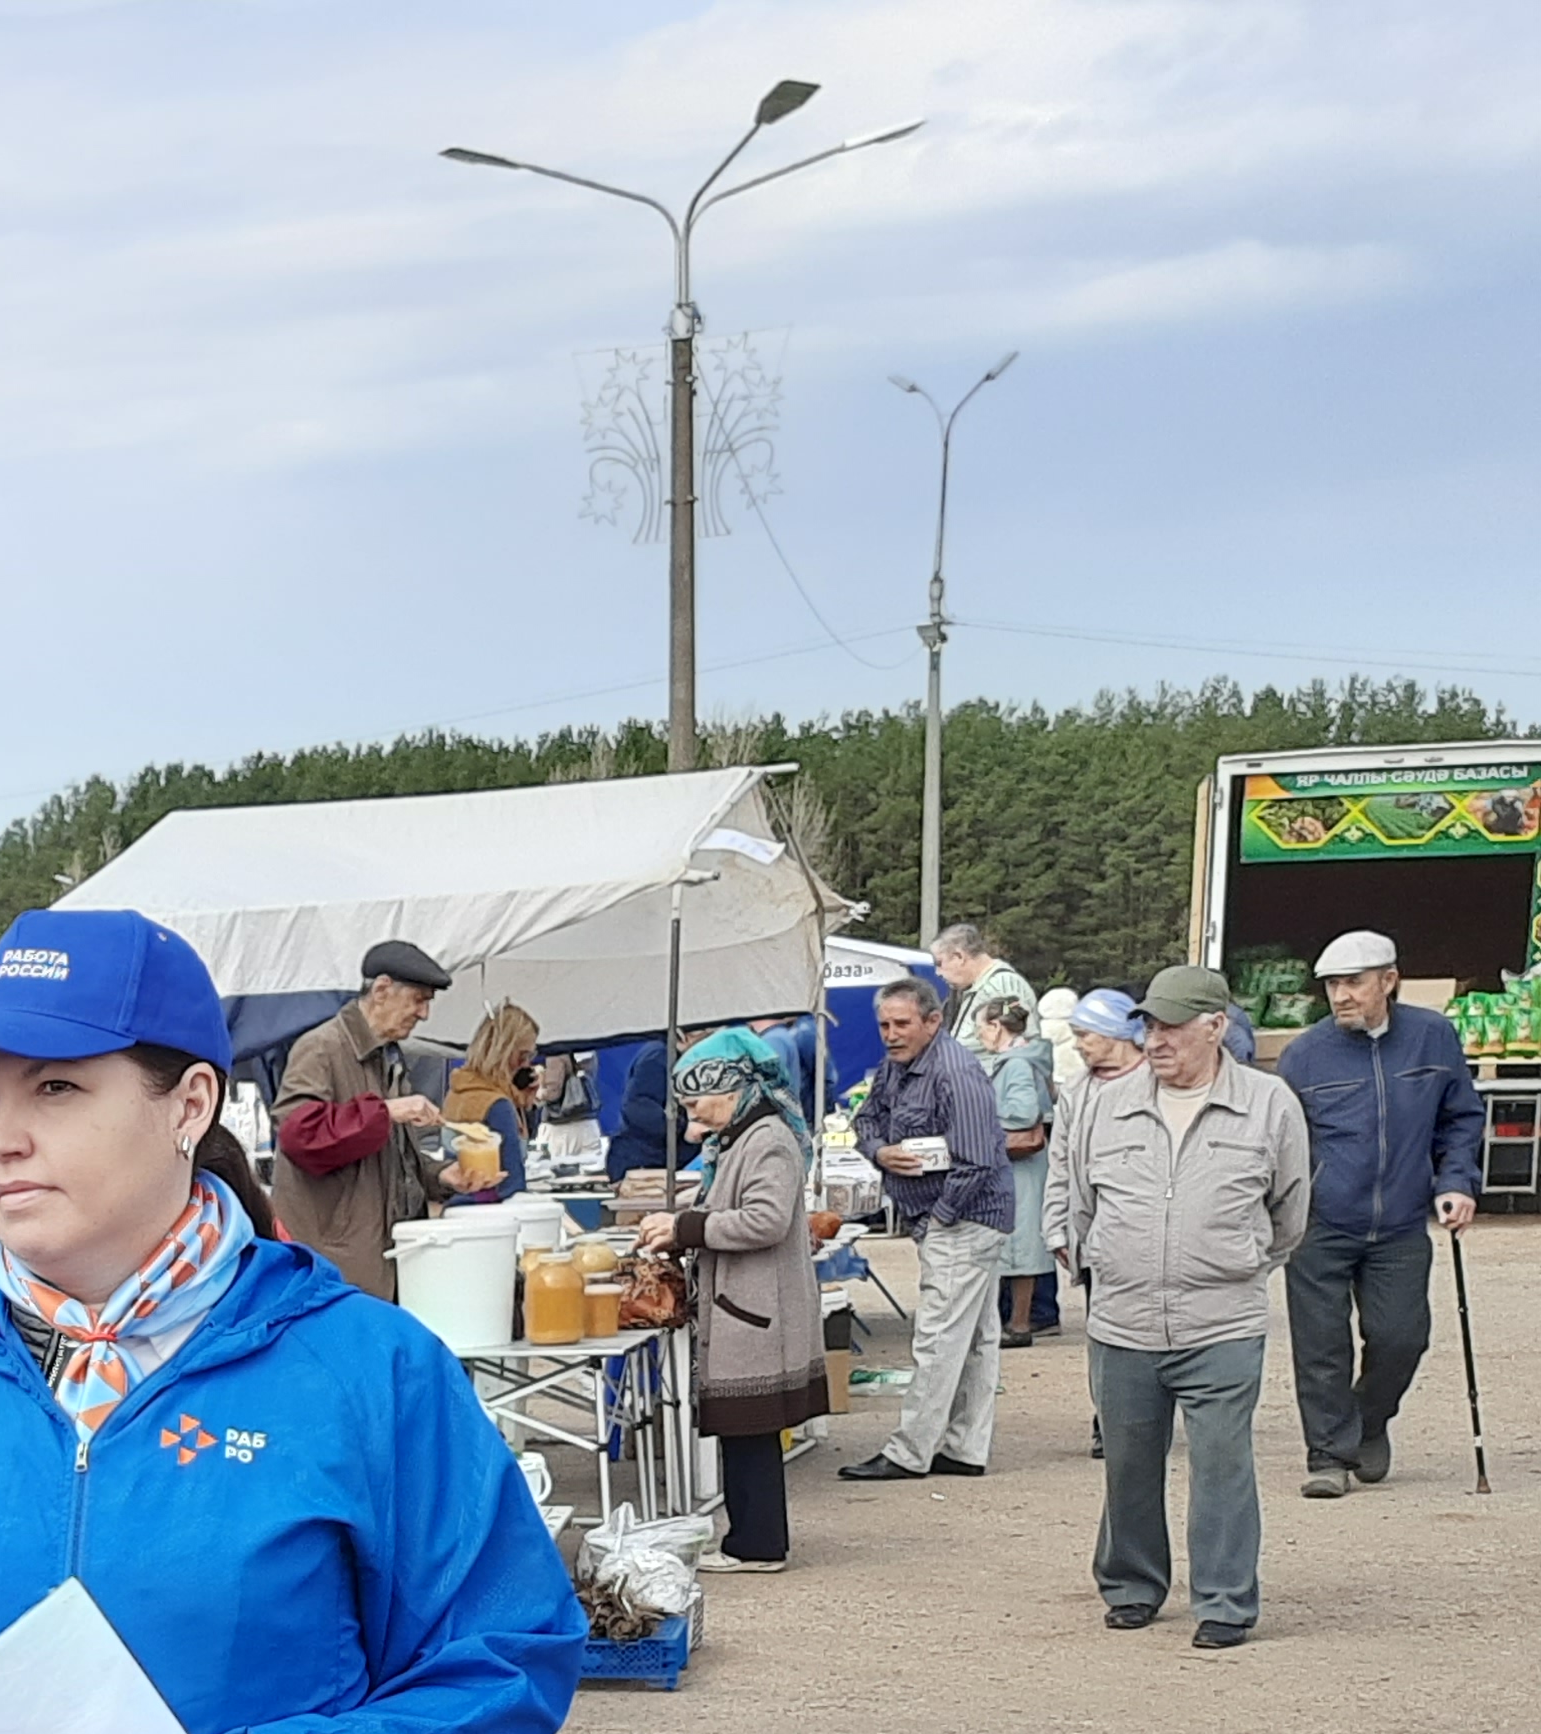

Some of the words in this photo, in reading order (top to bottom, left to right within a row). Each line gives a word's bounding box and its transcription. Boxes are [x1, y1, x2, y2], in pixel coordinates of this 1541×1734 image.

[1453, 765, 1529, 781] БАЗАСЫ
[2, 948, 69, 966] РАБОТА
[225, 1427, 268, 1449] РАБ
[224, 1444, 254, 1464] РО
